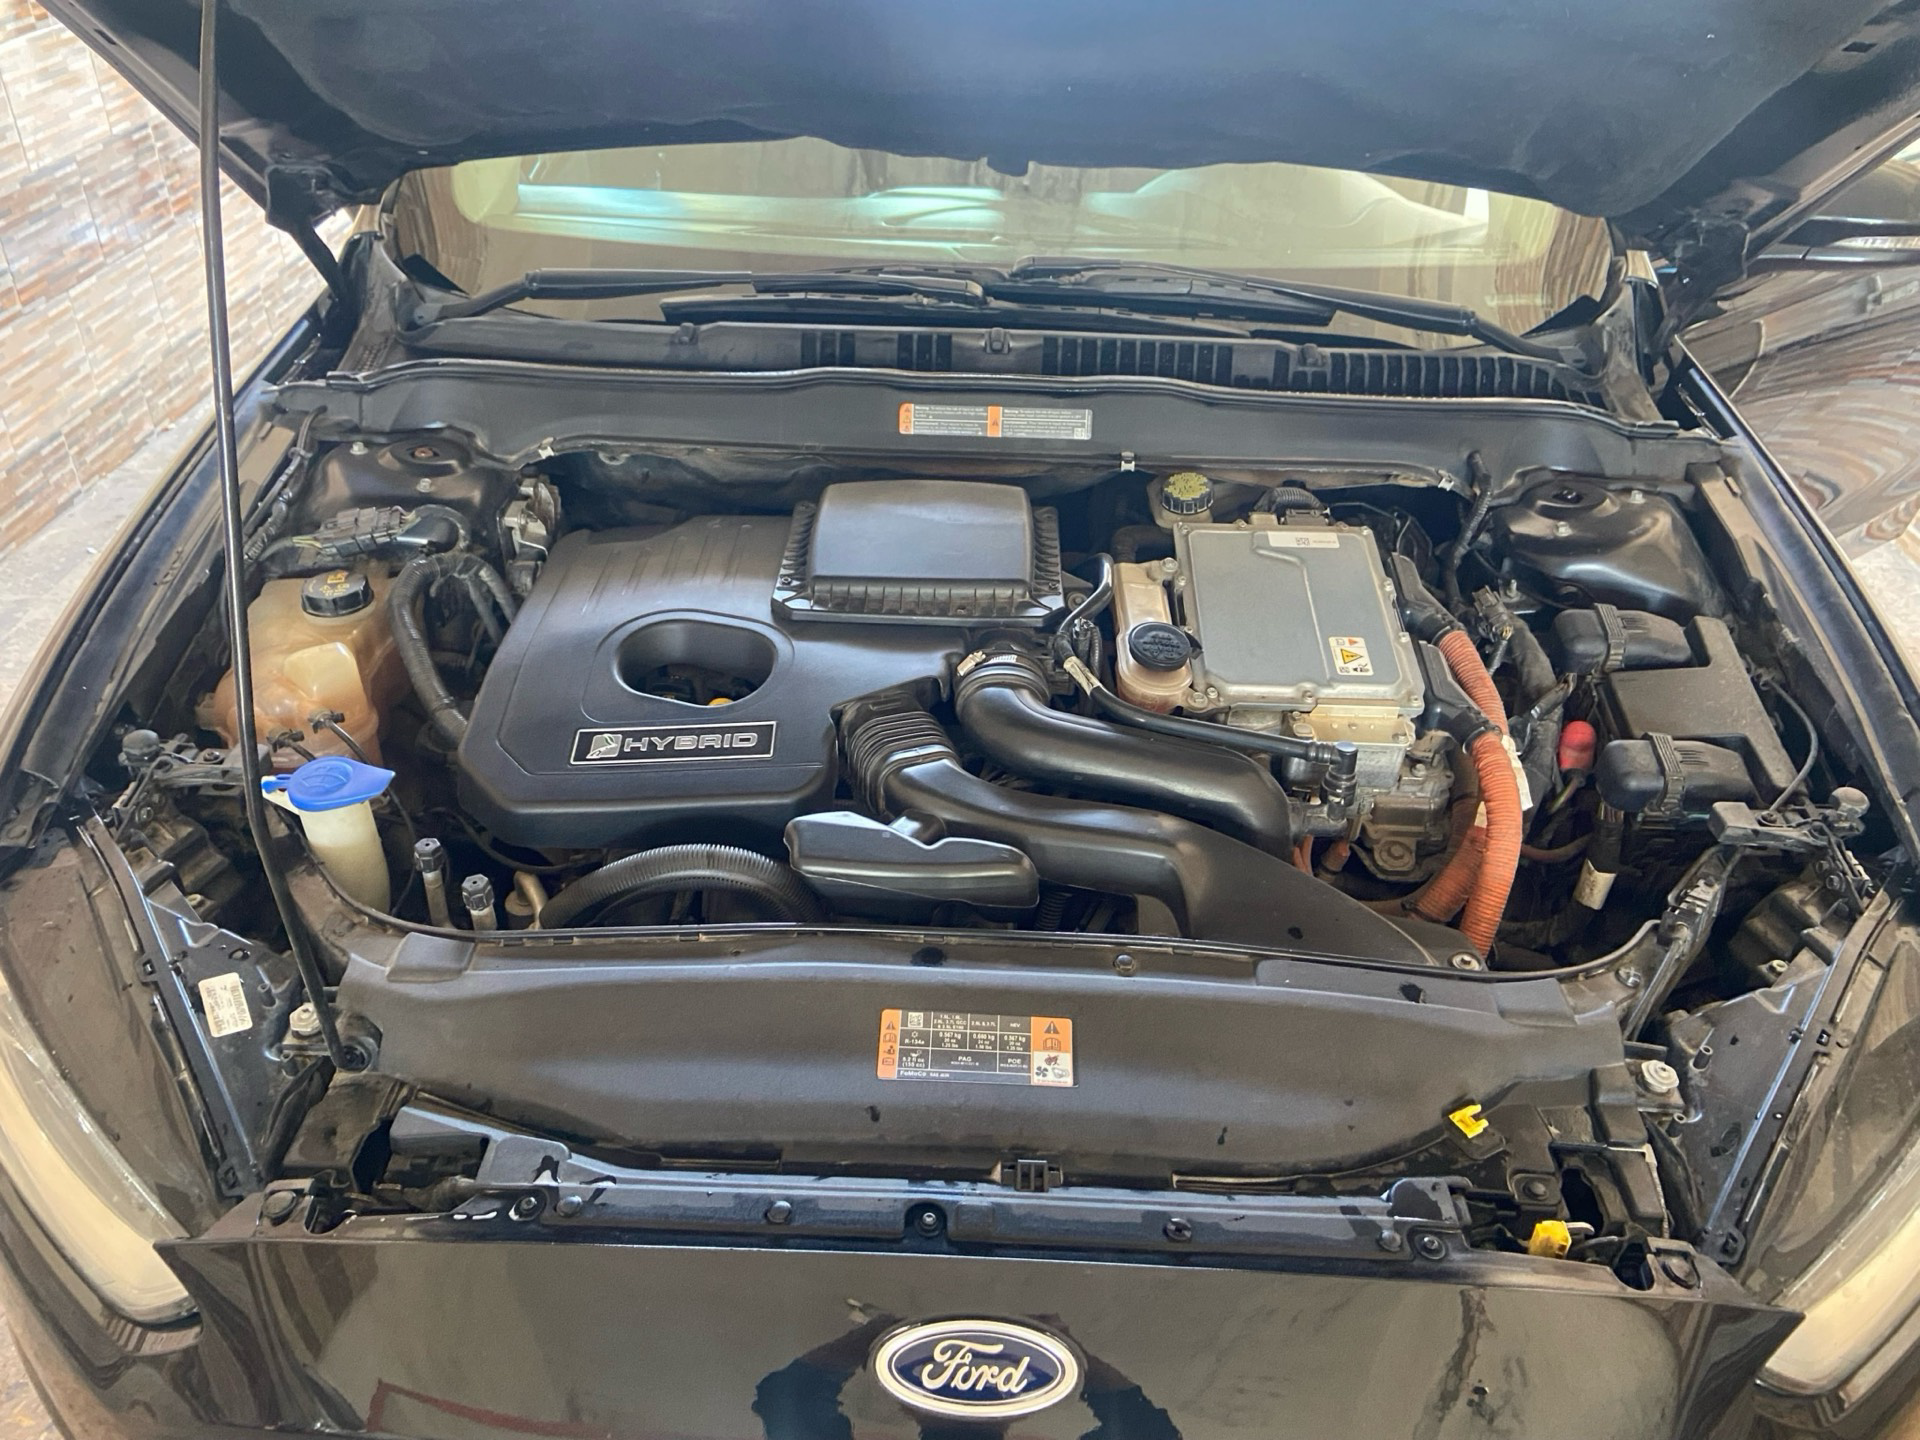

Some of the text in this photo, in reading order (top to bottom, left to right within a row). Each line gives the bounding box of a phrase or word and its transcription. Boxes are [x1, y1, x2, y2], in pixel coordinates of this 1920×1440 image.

[624, 733, 758, 752] HYBRID
[954, 1032, 961, 1040] kg
[921, 1339, 1030, 1394] Ford
